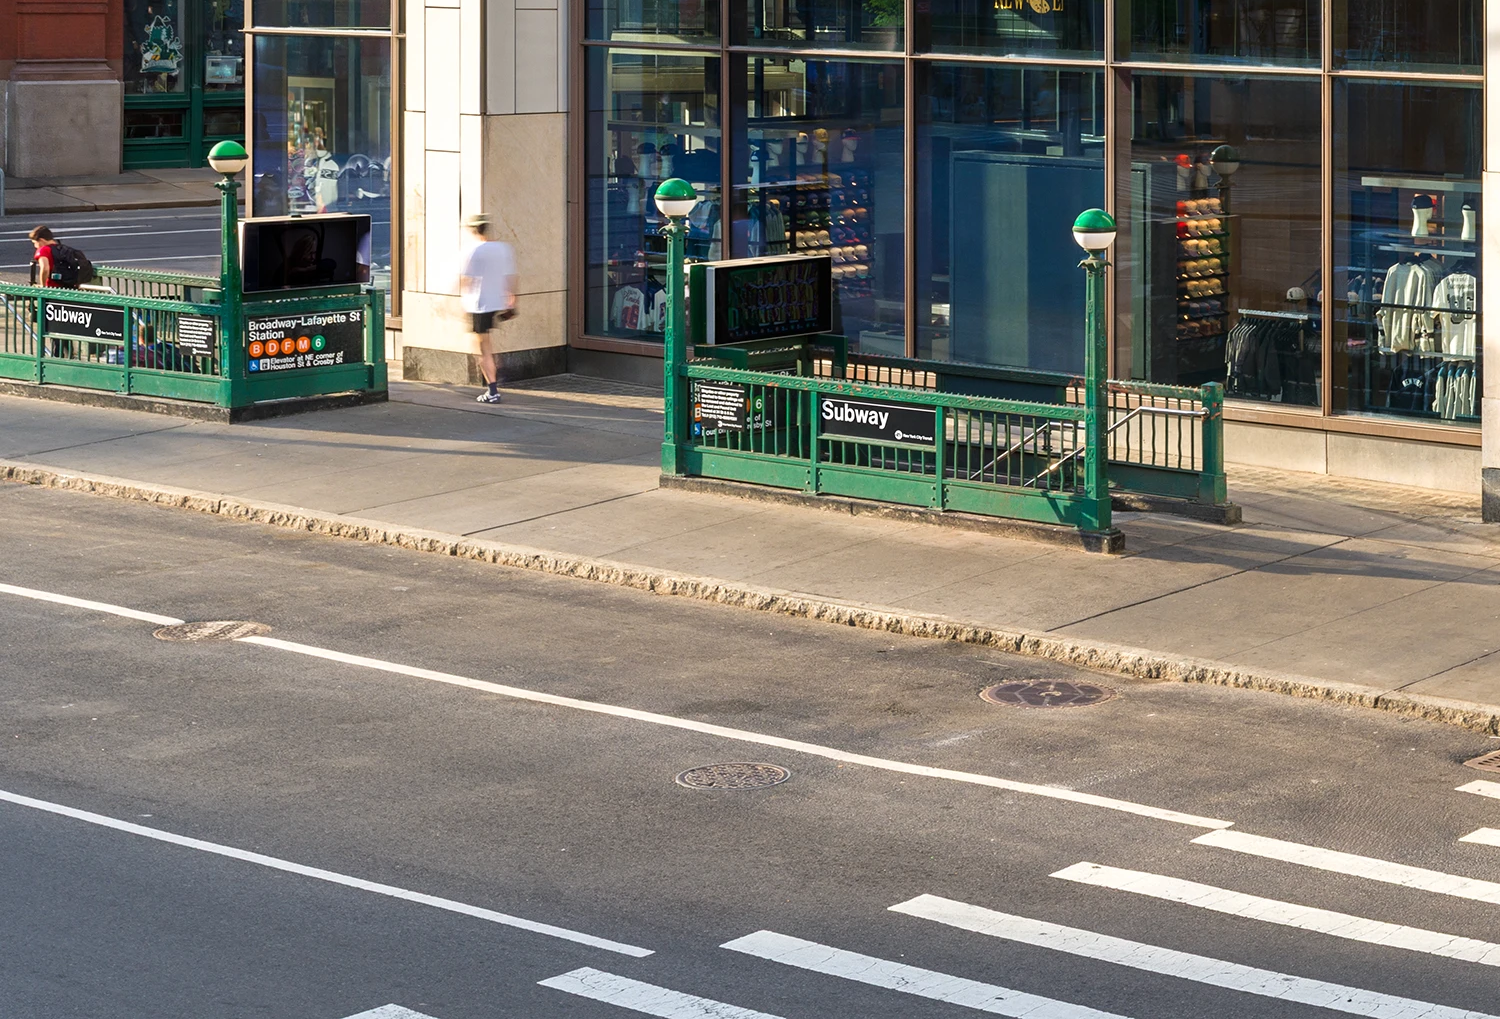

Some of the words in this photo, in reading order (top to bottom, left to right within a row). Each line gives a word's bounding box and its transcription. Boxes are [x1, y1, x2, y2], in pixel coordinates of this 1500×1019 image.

[45, 304, 92, 328] Subway
[248, 313, 346, 331] Broadway-Lafayette
[349, 311, 361, 322] St
[248, 329, 285, 342] Station
[270, 356, 295, 364] Elevator
[270, 361, 296, 370] Houston
[297, 360, 305, 368] St
[313, 358, 334, 366] Crosby
[755, 398, 762, 409] 6
[822, 400, 889, 430] Subway
